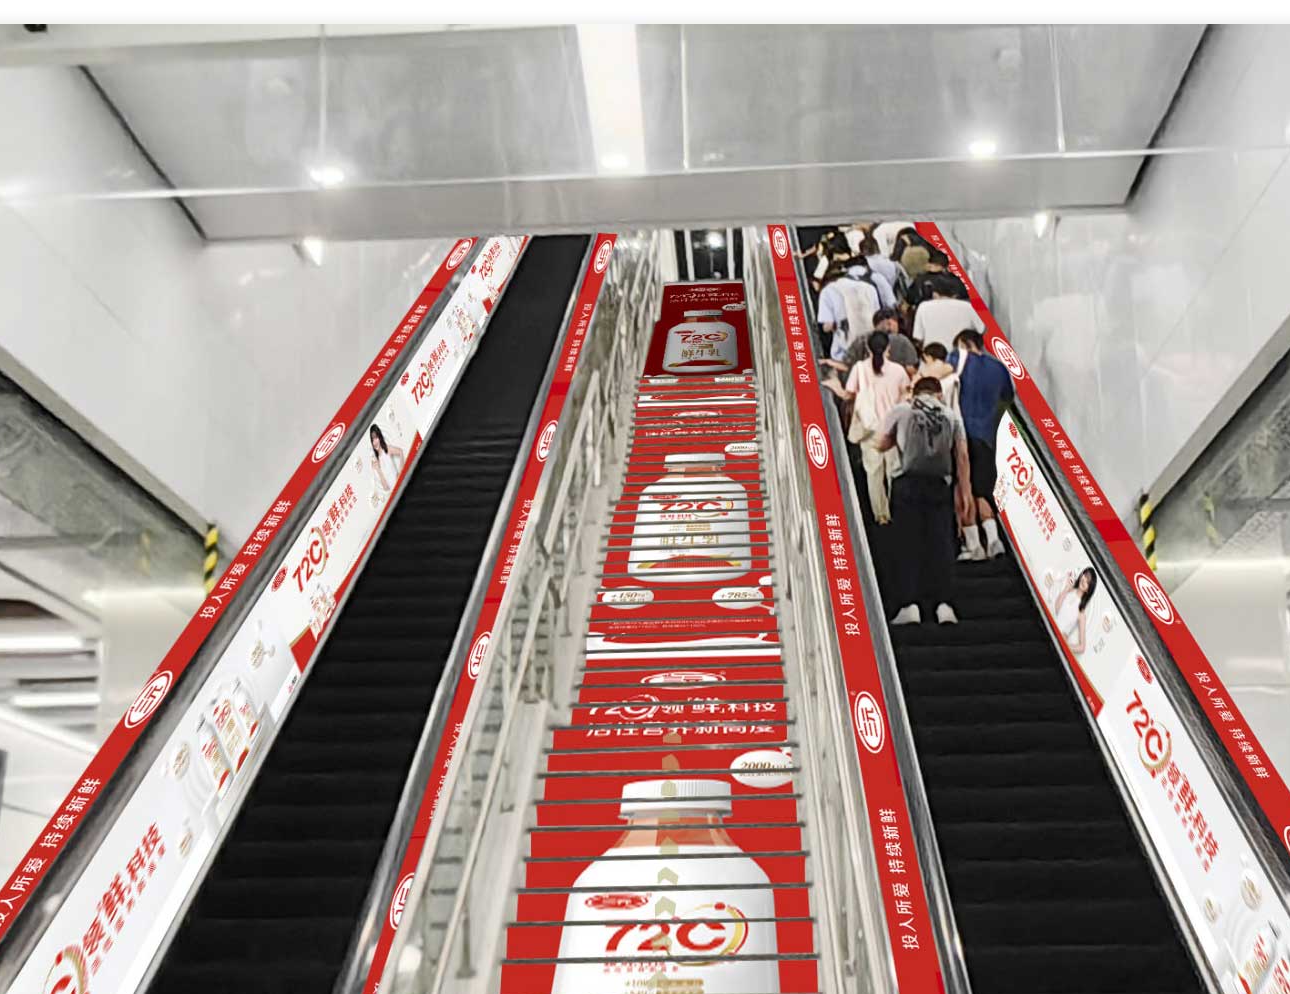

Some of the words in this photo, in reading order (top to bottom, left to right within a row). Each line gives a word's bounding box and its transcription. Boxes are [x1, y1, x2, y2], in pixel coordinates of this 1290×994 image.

[40, 778, 101, 849] 持续新鲜
[878, 808, 907, 874] 持续新鲜
[892, 882, 920, 950] 投人所爱
